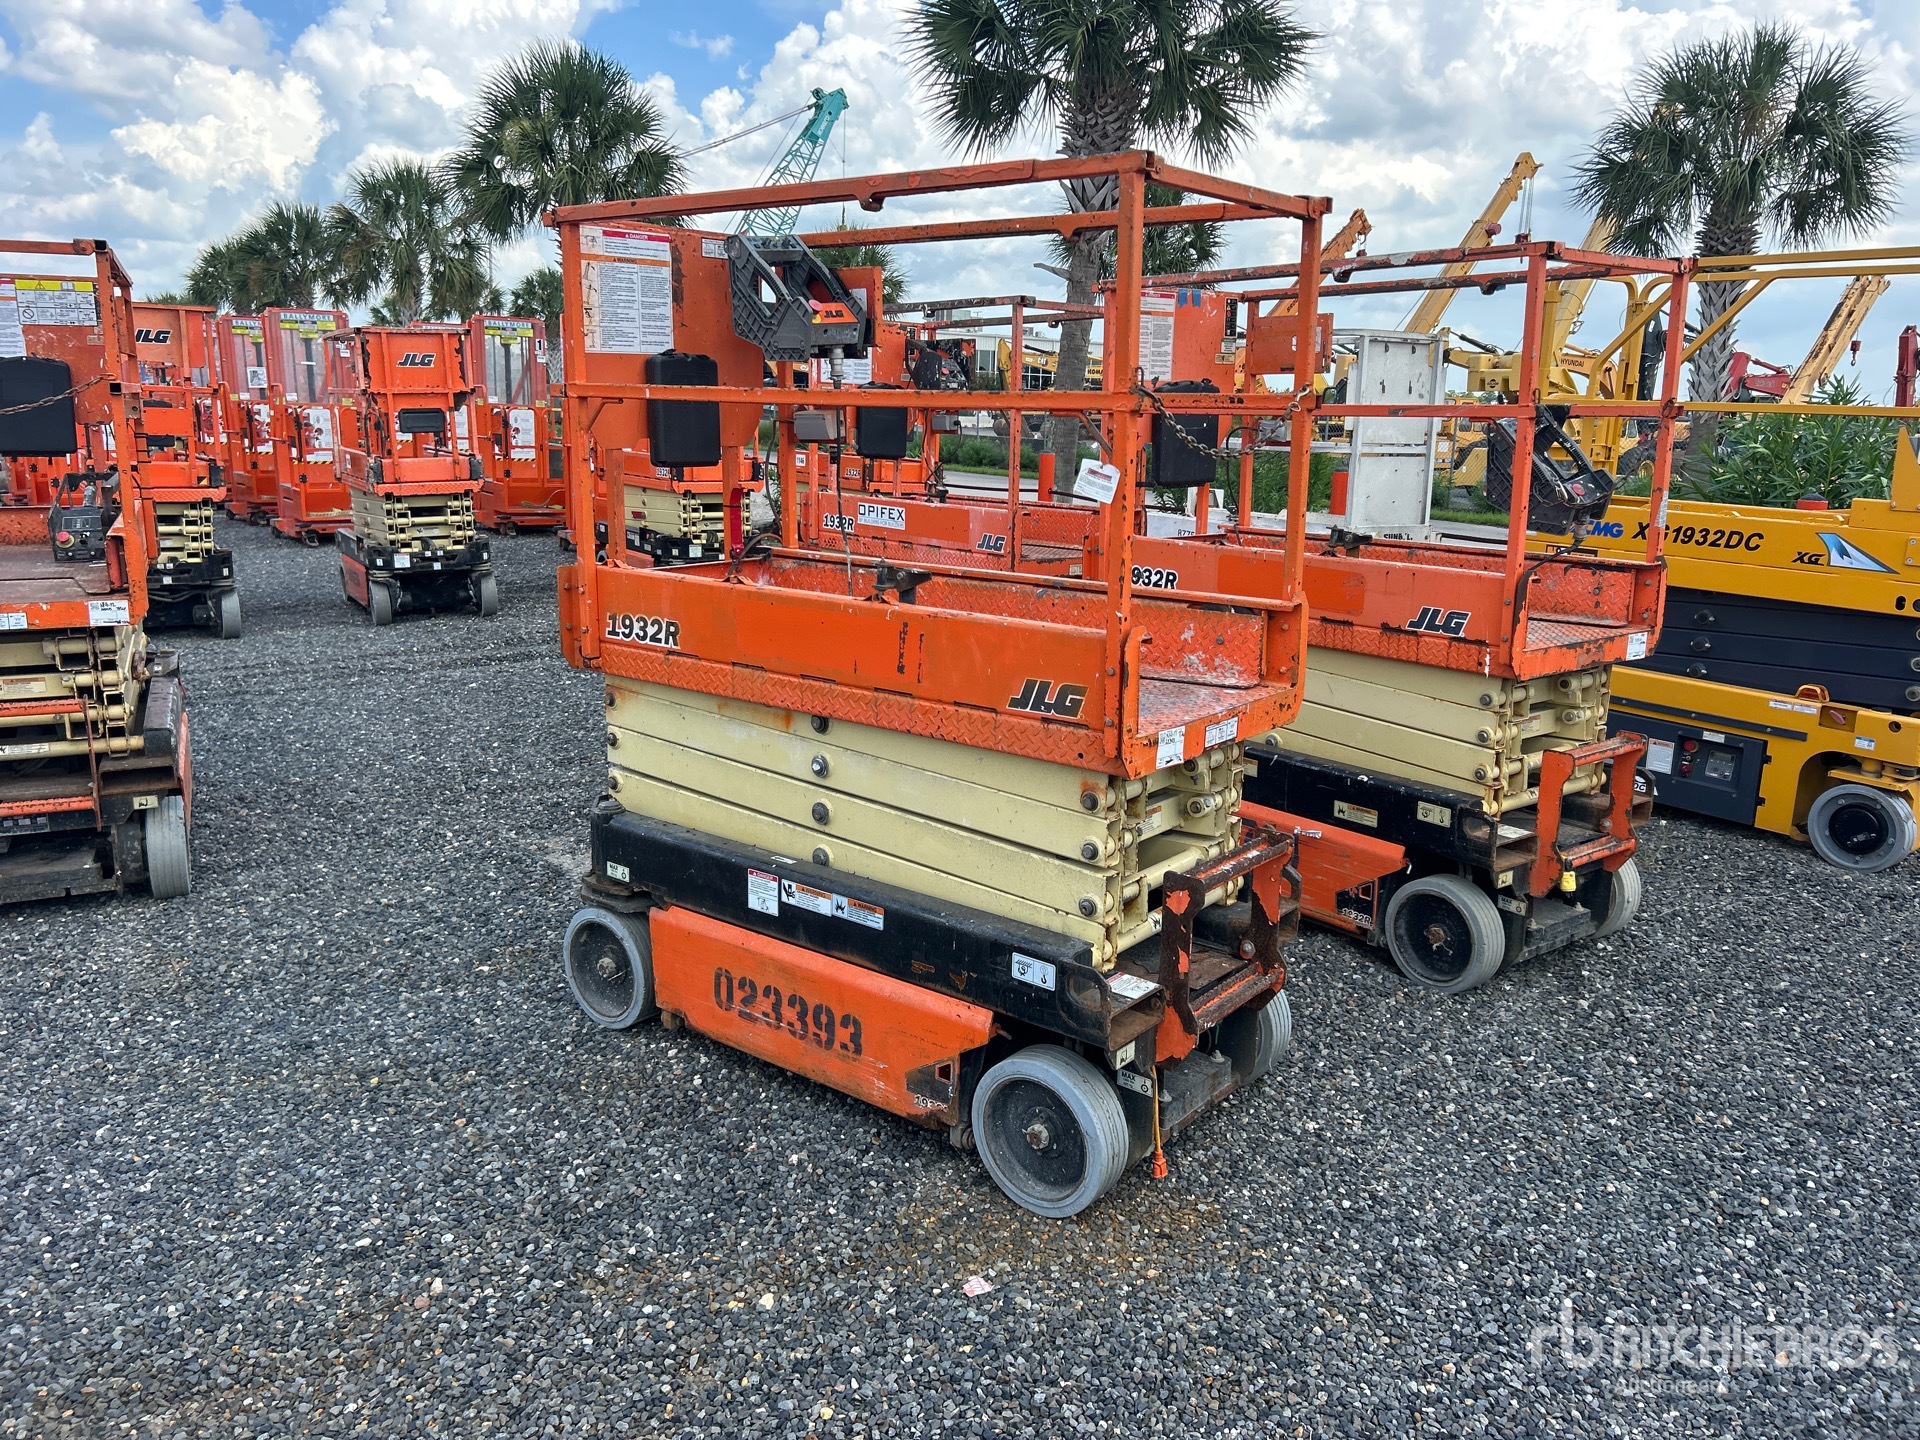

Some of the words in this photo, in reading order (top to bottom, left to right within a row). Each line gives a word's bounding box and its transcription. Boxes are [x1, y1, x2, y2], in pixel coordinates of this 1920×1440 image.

[824, 310, 844, 318] JLG
[398, 353, 435, 367] JLG
[1560, 358, 1585, 367] HYUNDAI
[858, 504, 905, 521] OPIFEX
[977, 533, 1006, 553] JLG
[1791, 551, 1826, 566] XG
[1131, 566, 1178, 589] 932R
[607, 612, 680, 647] 1932R
[1407, 607, 1471, 637] JLG
[1007, 678, 1089, 719] JLG
[714, 967, 863, 1061] 023393
[1121, 1070, 1136, 1081] MAX
